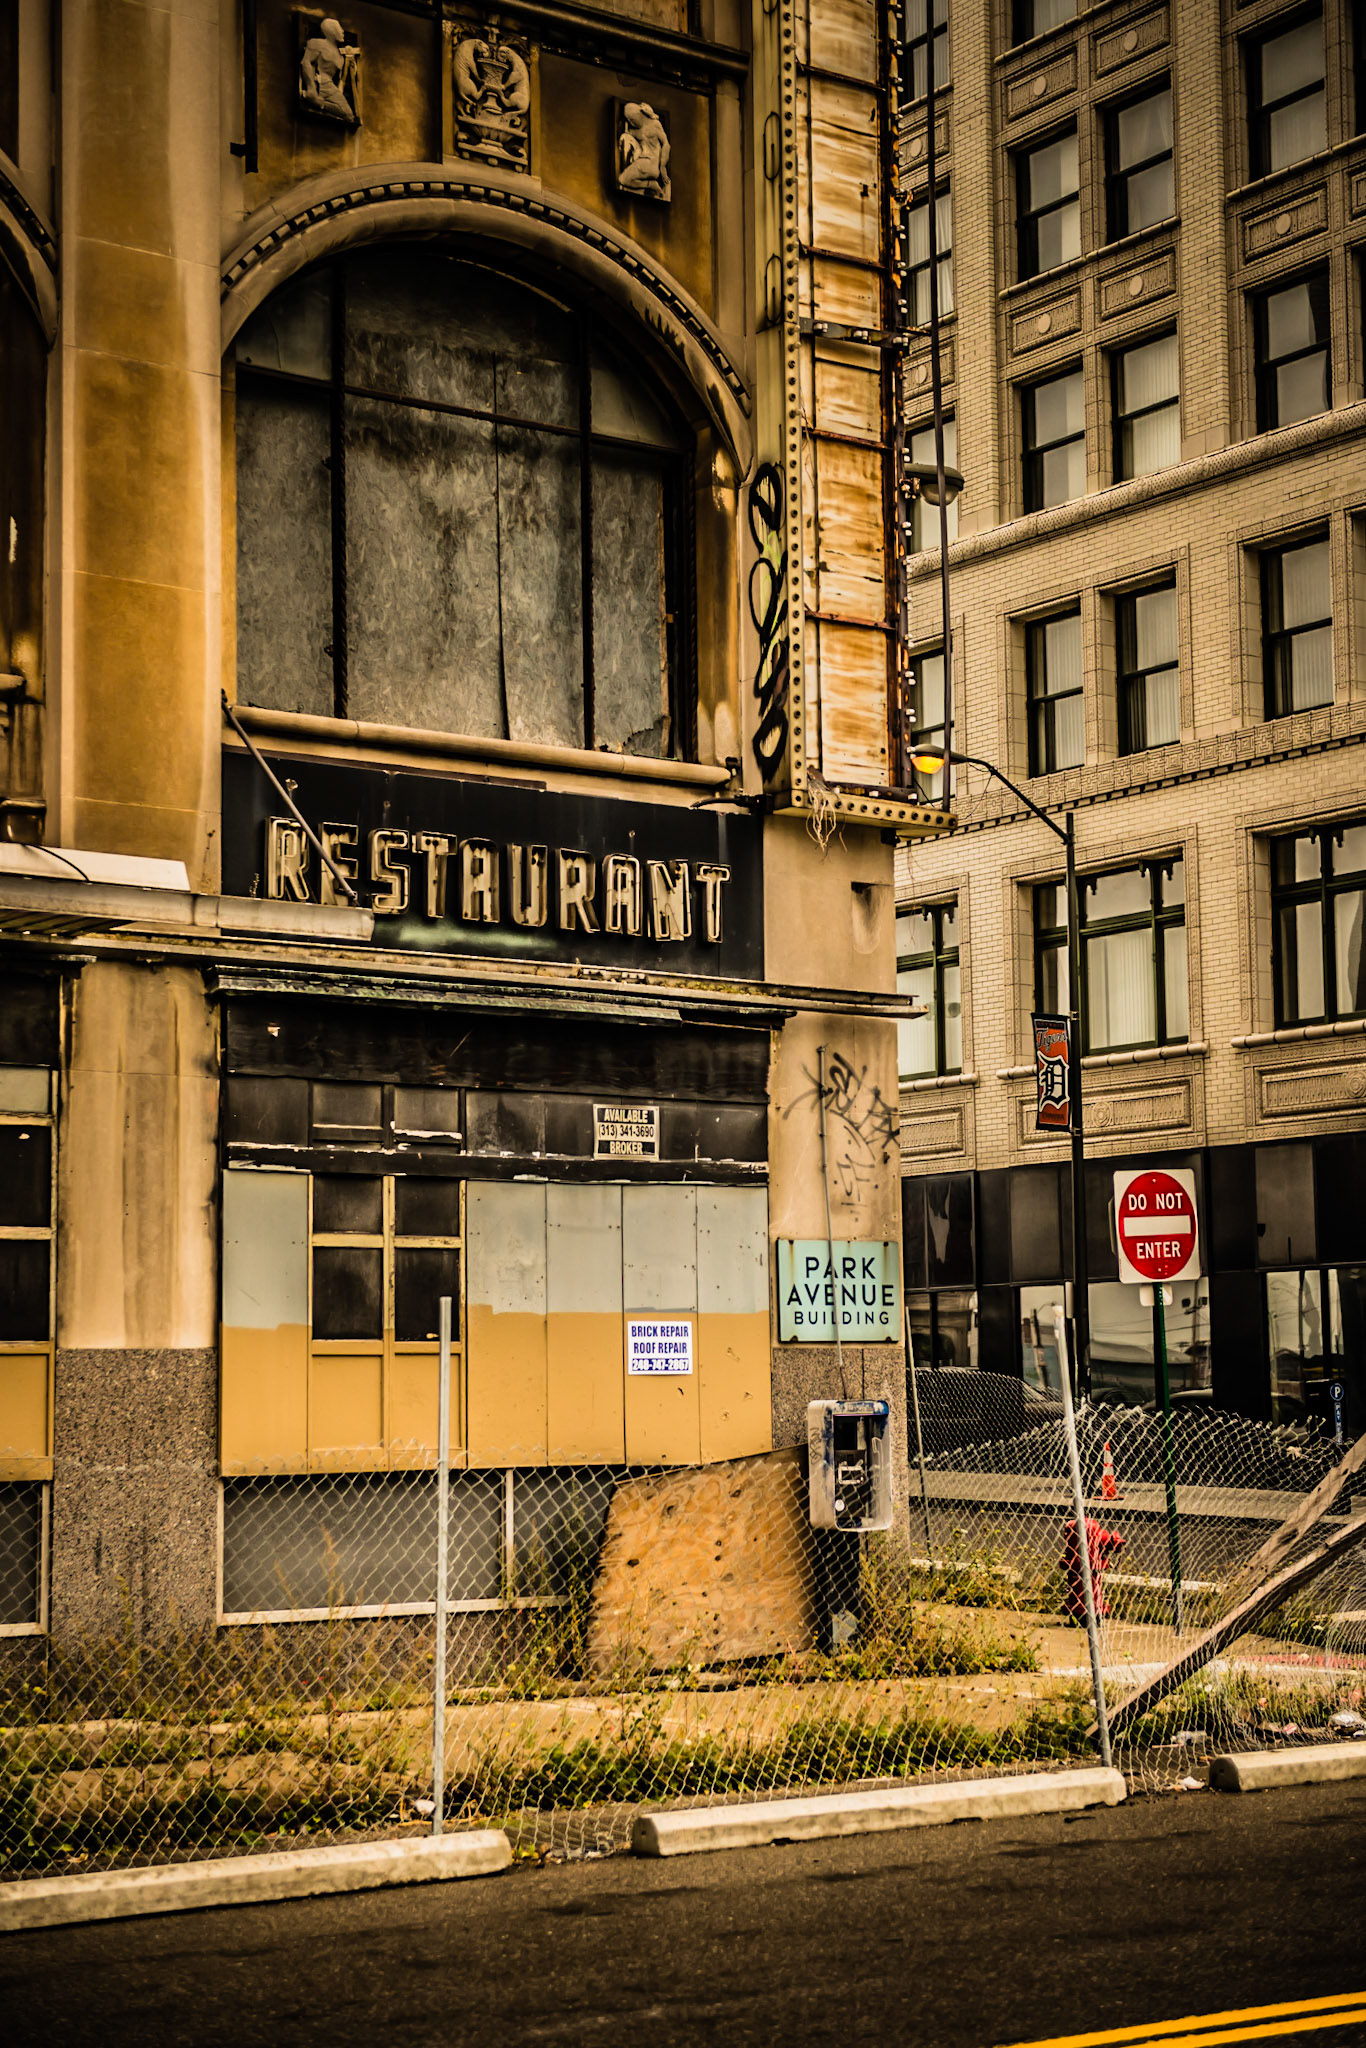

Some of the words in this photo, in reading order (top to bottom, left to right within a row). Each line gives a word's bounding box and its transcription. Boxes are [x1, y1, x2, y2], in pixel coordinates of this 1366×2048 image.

[264, 816, 732, 944] RESTAURANT
[604, 1108, 648, 1123] AVAILABLE
[599, 1124, 617, 1139] (313)
[620, 1125, 654, 1138] 341-3690
[610, 1141, 643, 1155] BROKER
[1128, 1193, 1147, 1211] DO
[1155, 1192, 1183, 1210] NOT
[1136, 1241, 1181, 1259] ENTER
[806, 1257, 876, 1279] PARK
[787, 1284, 894, 1306] AVENUE
[794, 1311, 889, 1325] BUILDING
[631, 1326, 658, 1337] BRICK
[660, 1326, 688, 1337] REPAIR
[633, 1342, 655, 1353] ROOF
[658, 1342, 687, 1353] REPAIR
[1334, 1386, 1341, 1398] P
